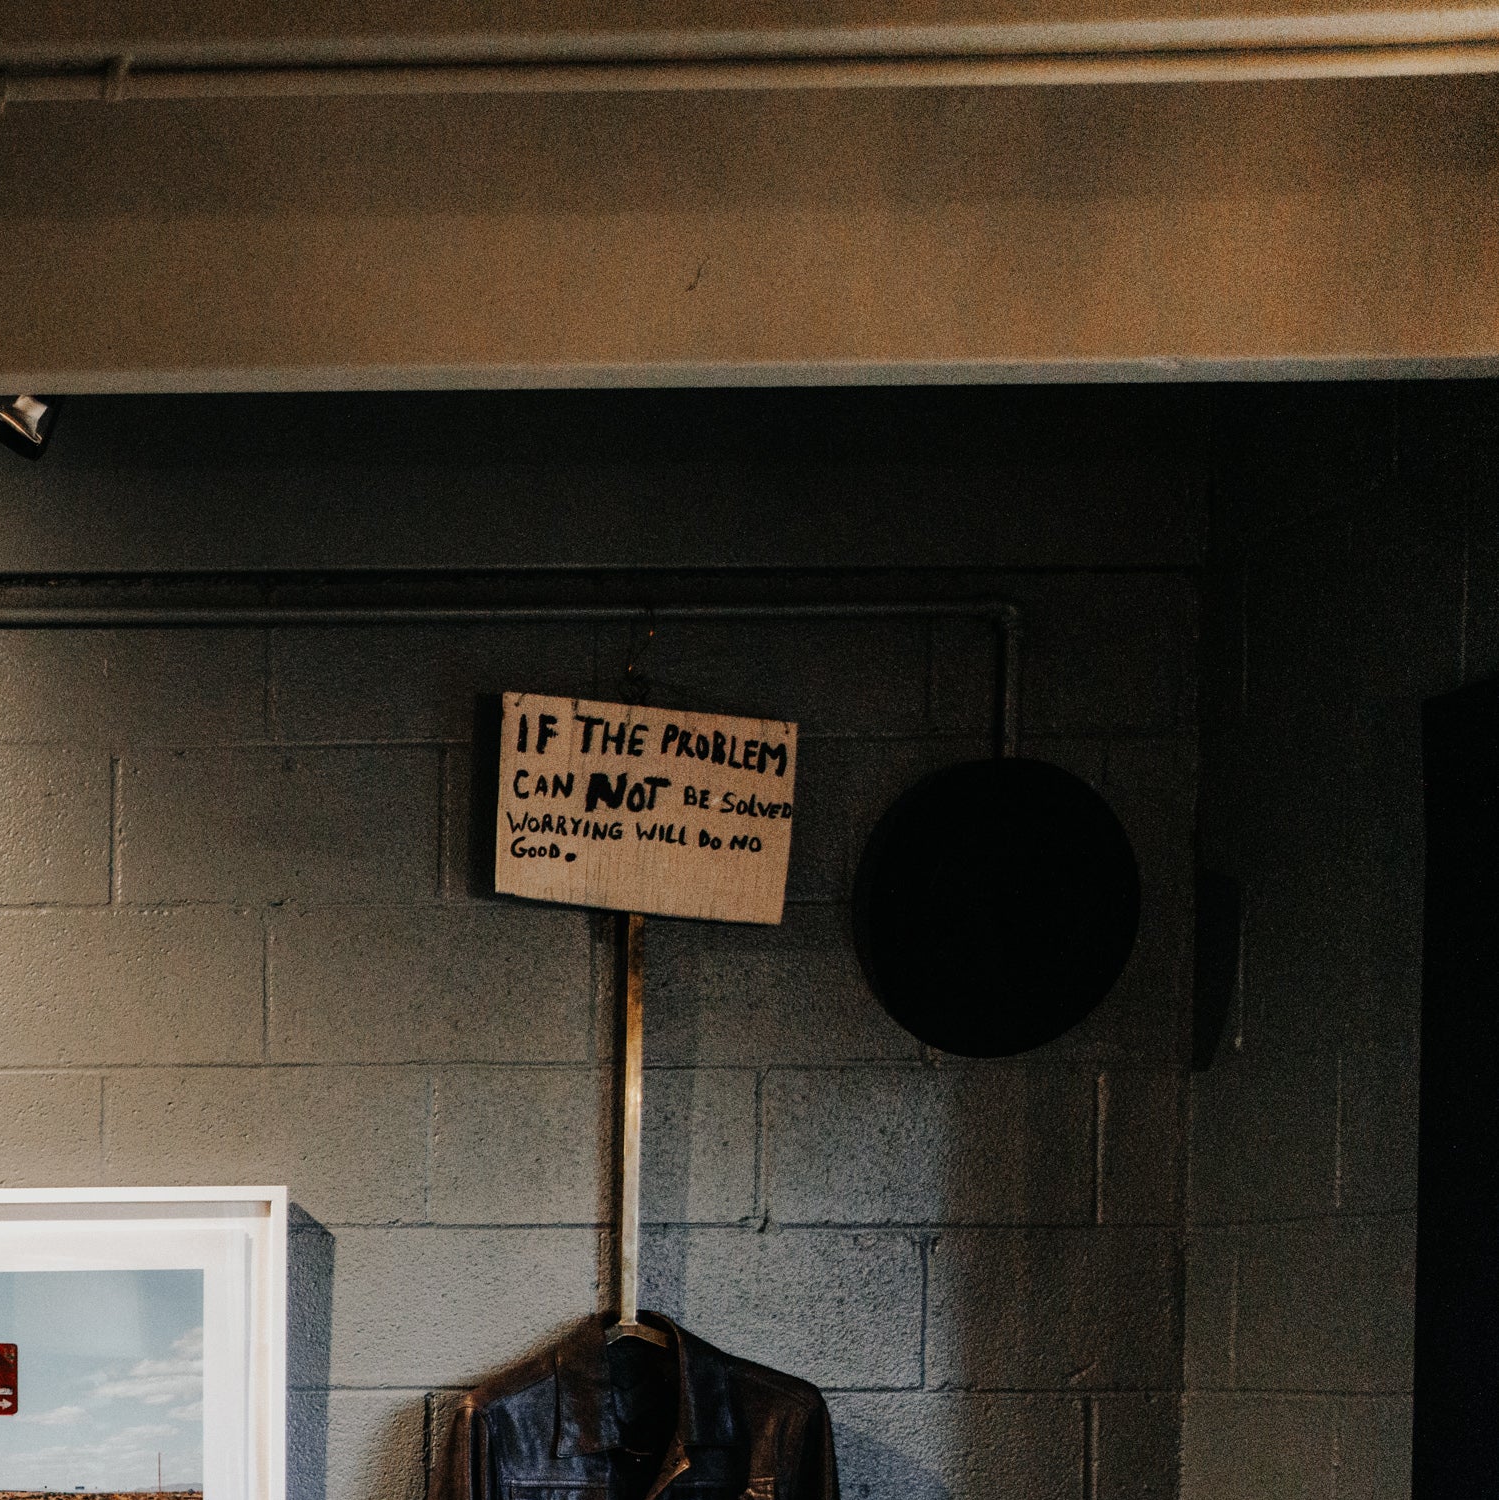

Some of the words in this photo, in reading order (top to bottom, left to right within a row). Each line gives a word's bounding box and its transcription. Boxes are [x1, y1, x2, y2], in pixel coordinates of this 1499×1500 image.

[516, 713, 559, 755] IF
[574, 713, 649, 757] THE
[660, 723, 788, 778] PROBLEM
[512, 769, 575, 800] CAN
[584, 771, 672, 813] NOT
[682, 785, 711, 809] BE
[718, 791, 793, 820] SOLVED
[505, 811, 623, 841] WORRYING
[635, 821, 688, 846] WILL
[729, 834, 763, 853] NO
